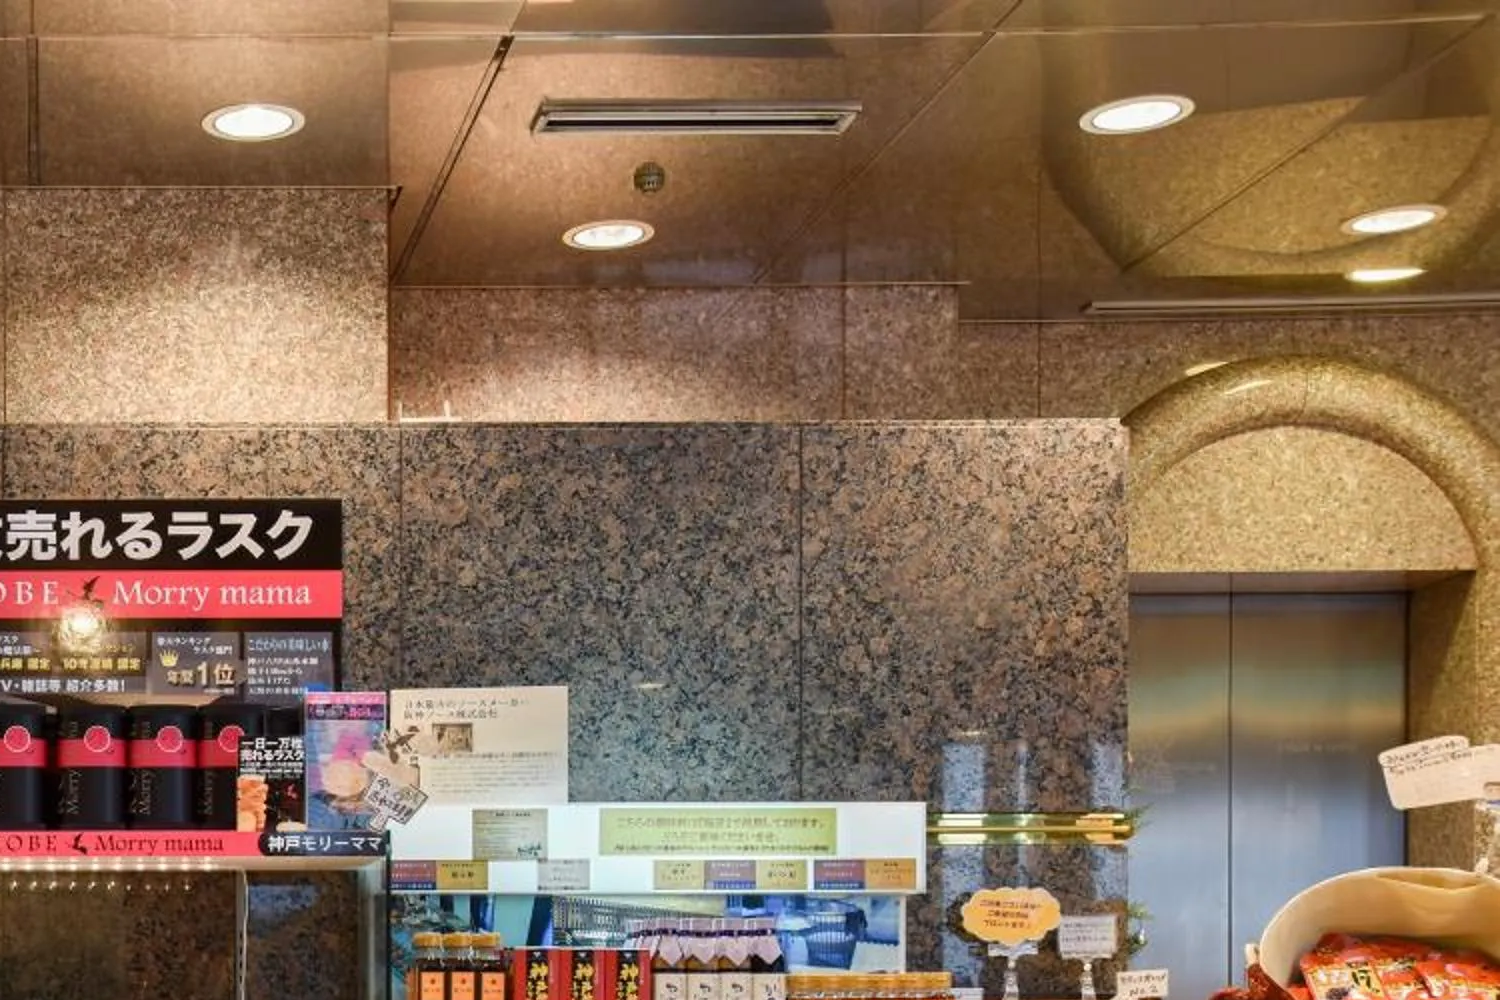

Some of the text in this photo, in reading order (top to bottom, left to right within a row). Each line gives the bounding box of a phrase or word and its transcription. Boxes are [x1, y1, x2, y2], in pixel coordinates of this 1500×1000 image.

[113, 580, 212, 612] Morry
[219, 584, 312, 604] mama
[94, 834, 159, 856] Morry
[163, 837, 225, 852] mama
[266, 835, 383, 852] 神戸モリーママ
